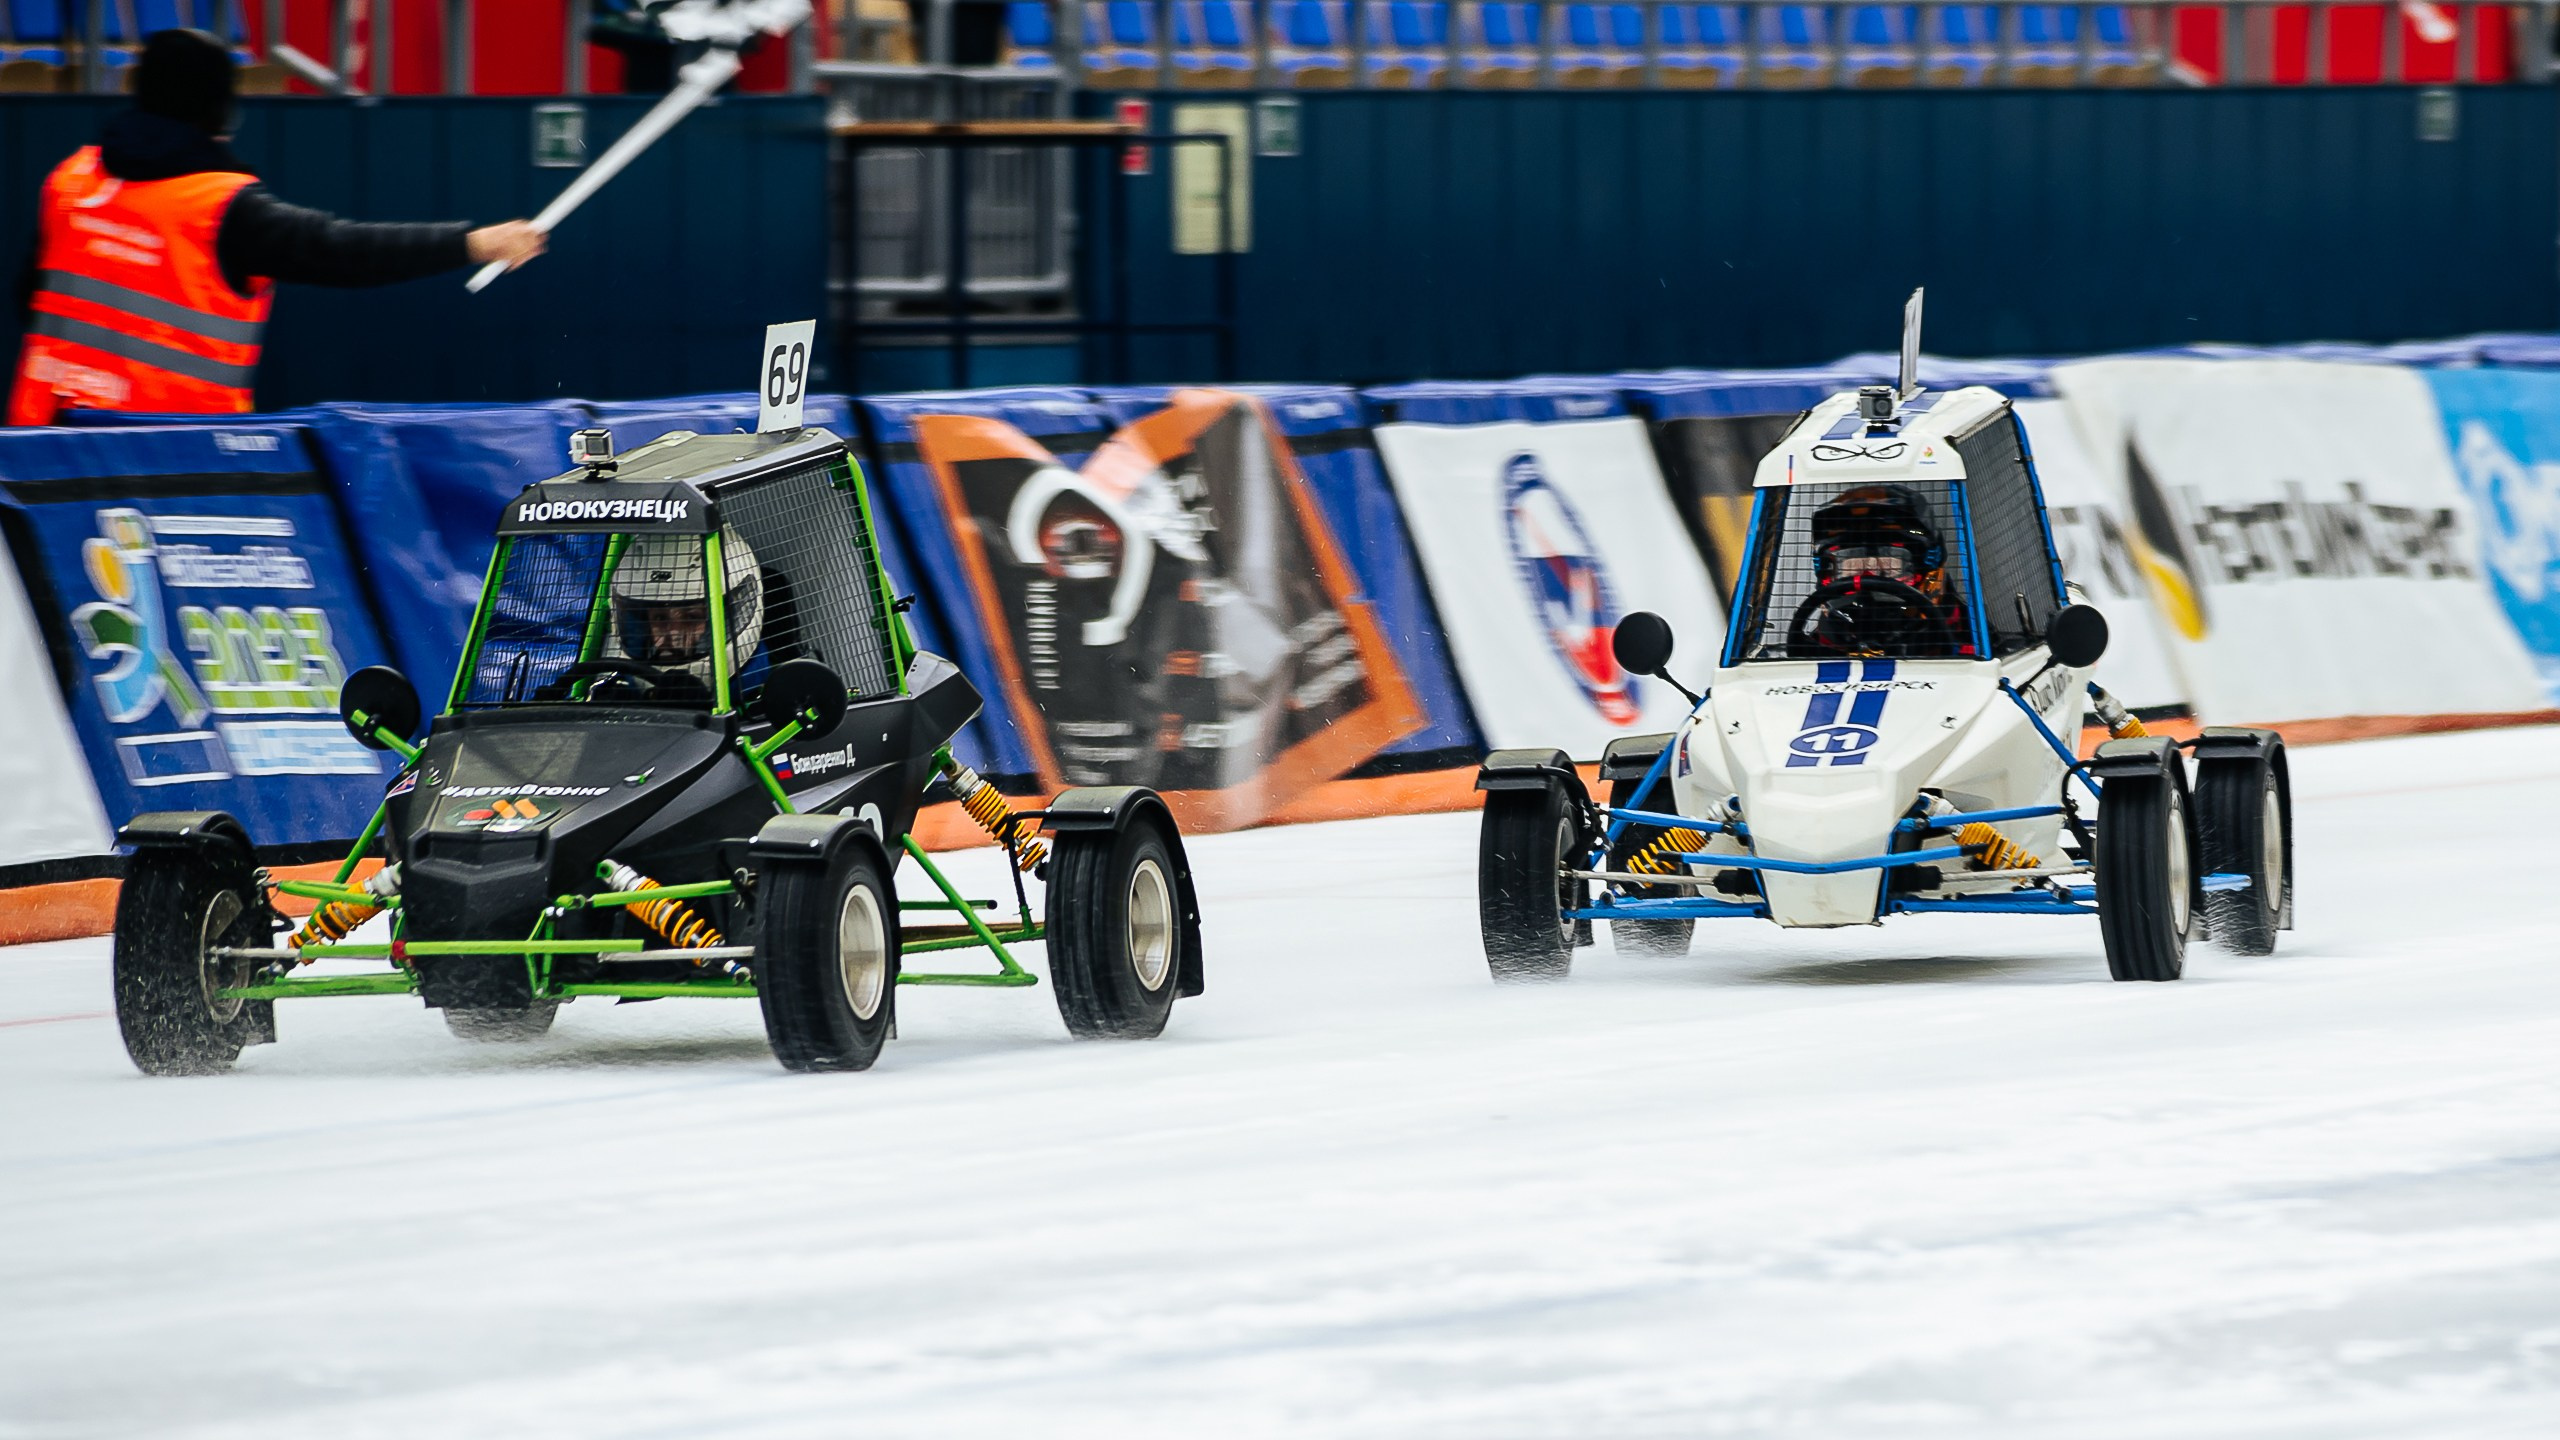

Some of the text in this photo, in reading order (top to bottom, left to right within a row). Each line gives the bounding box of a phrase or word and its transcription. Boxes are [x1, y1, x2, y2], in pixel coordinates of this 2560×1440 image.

[767, 342, 805, 407] 69
[517, 500, 689, 524] НОВОКУЗНЕЦК
[1801, 732, 1859, 751] 11
[790, 743, 857, 774] Бондаренко Д
